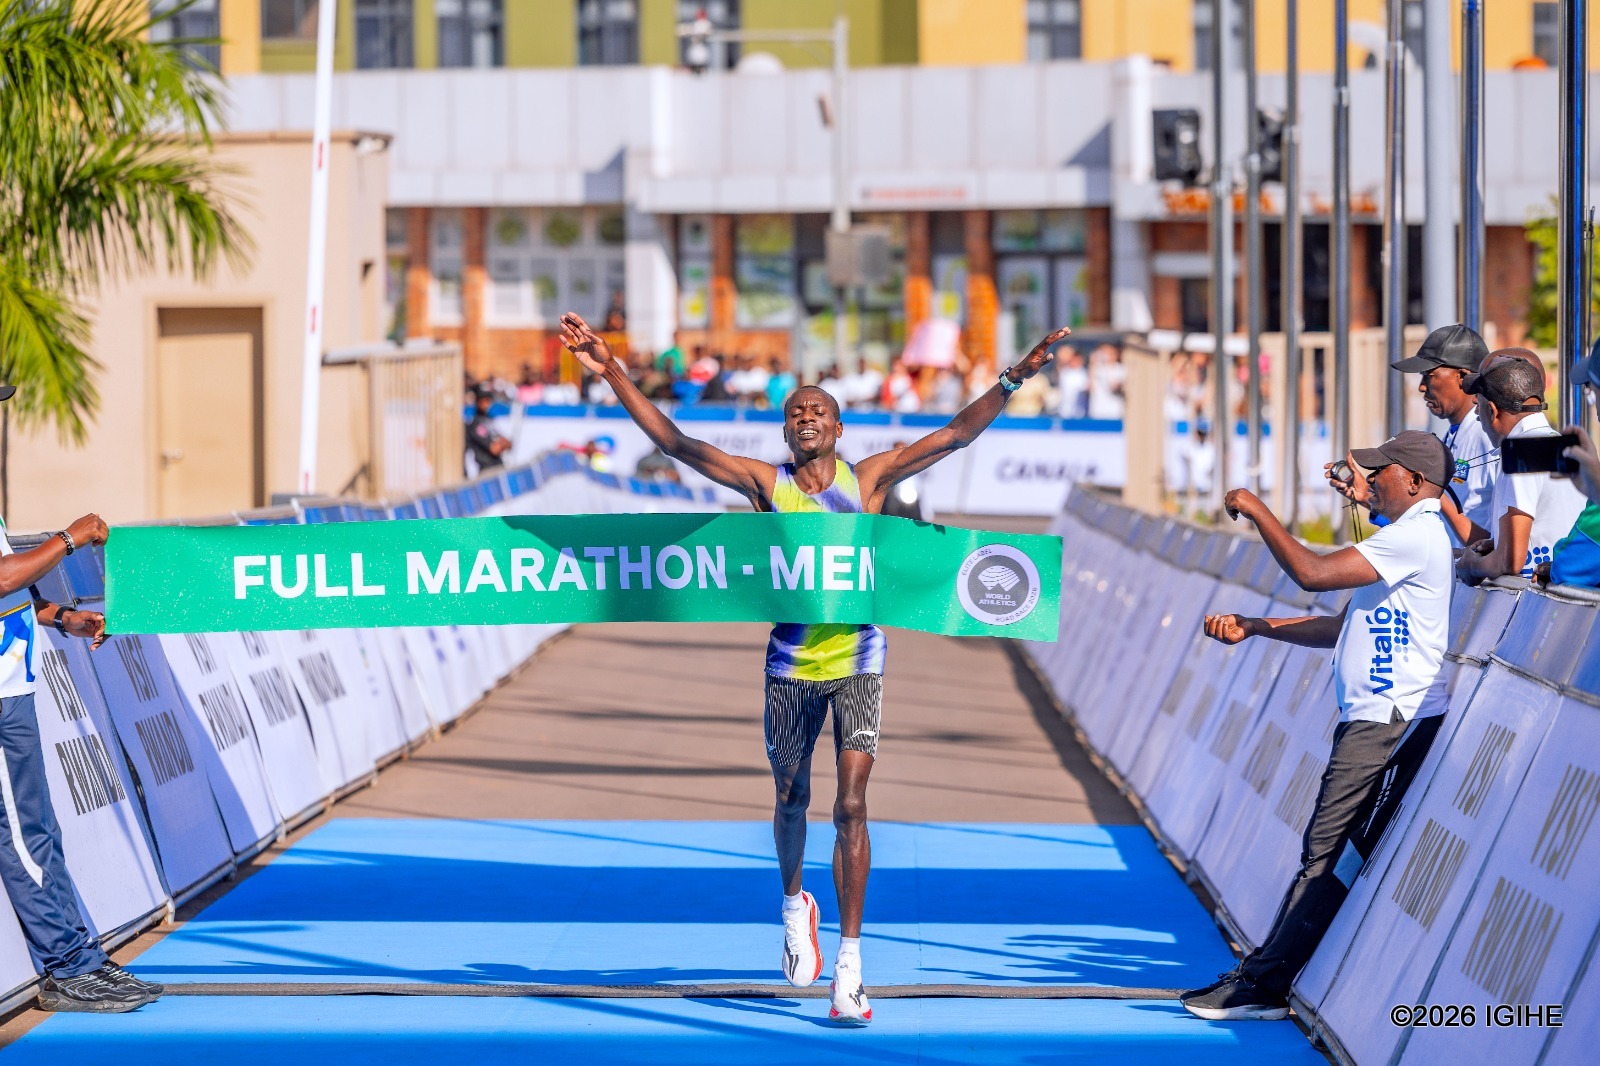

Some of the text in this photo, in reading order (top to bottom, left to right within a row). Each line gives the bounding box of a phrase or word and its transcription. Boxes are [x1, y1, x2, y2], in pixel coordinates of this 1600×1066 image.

[233, 552, 386, 600] FULL
[406, 545, 728, 595] MARATHON
[769, 545, 876, 592] MEN
[979, 599, 1017, 607] ATHLETICS
[985, 592, 1011, 600] WORLD
[1451, 721, 1517, 820] VISIT
